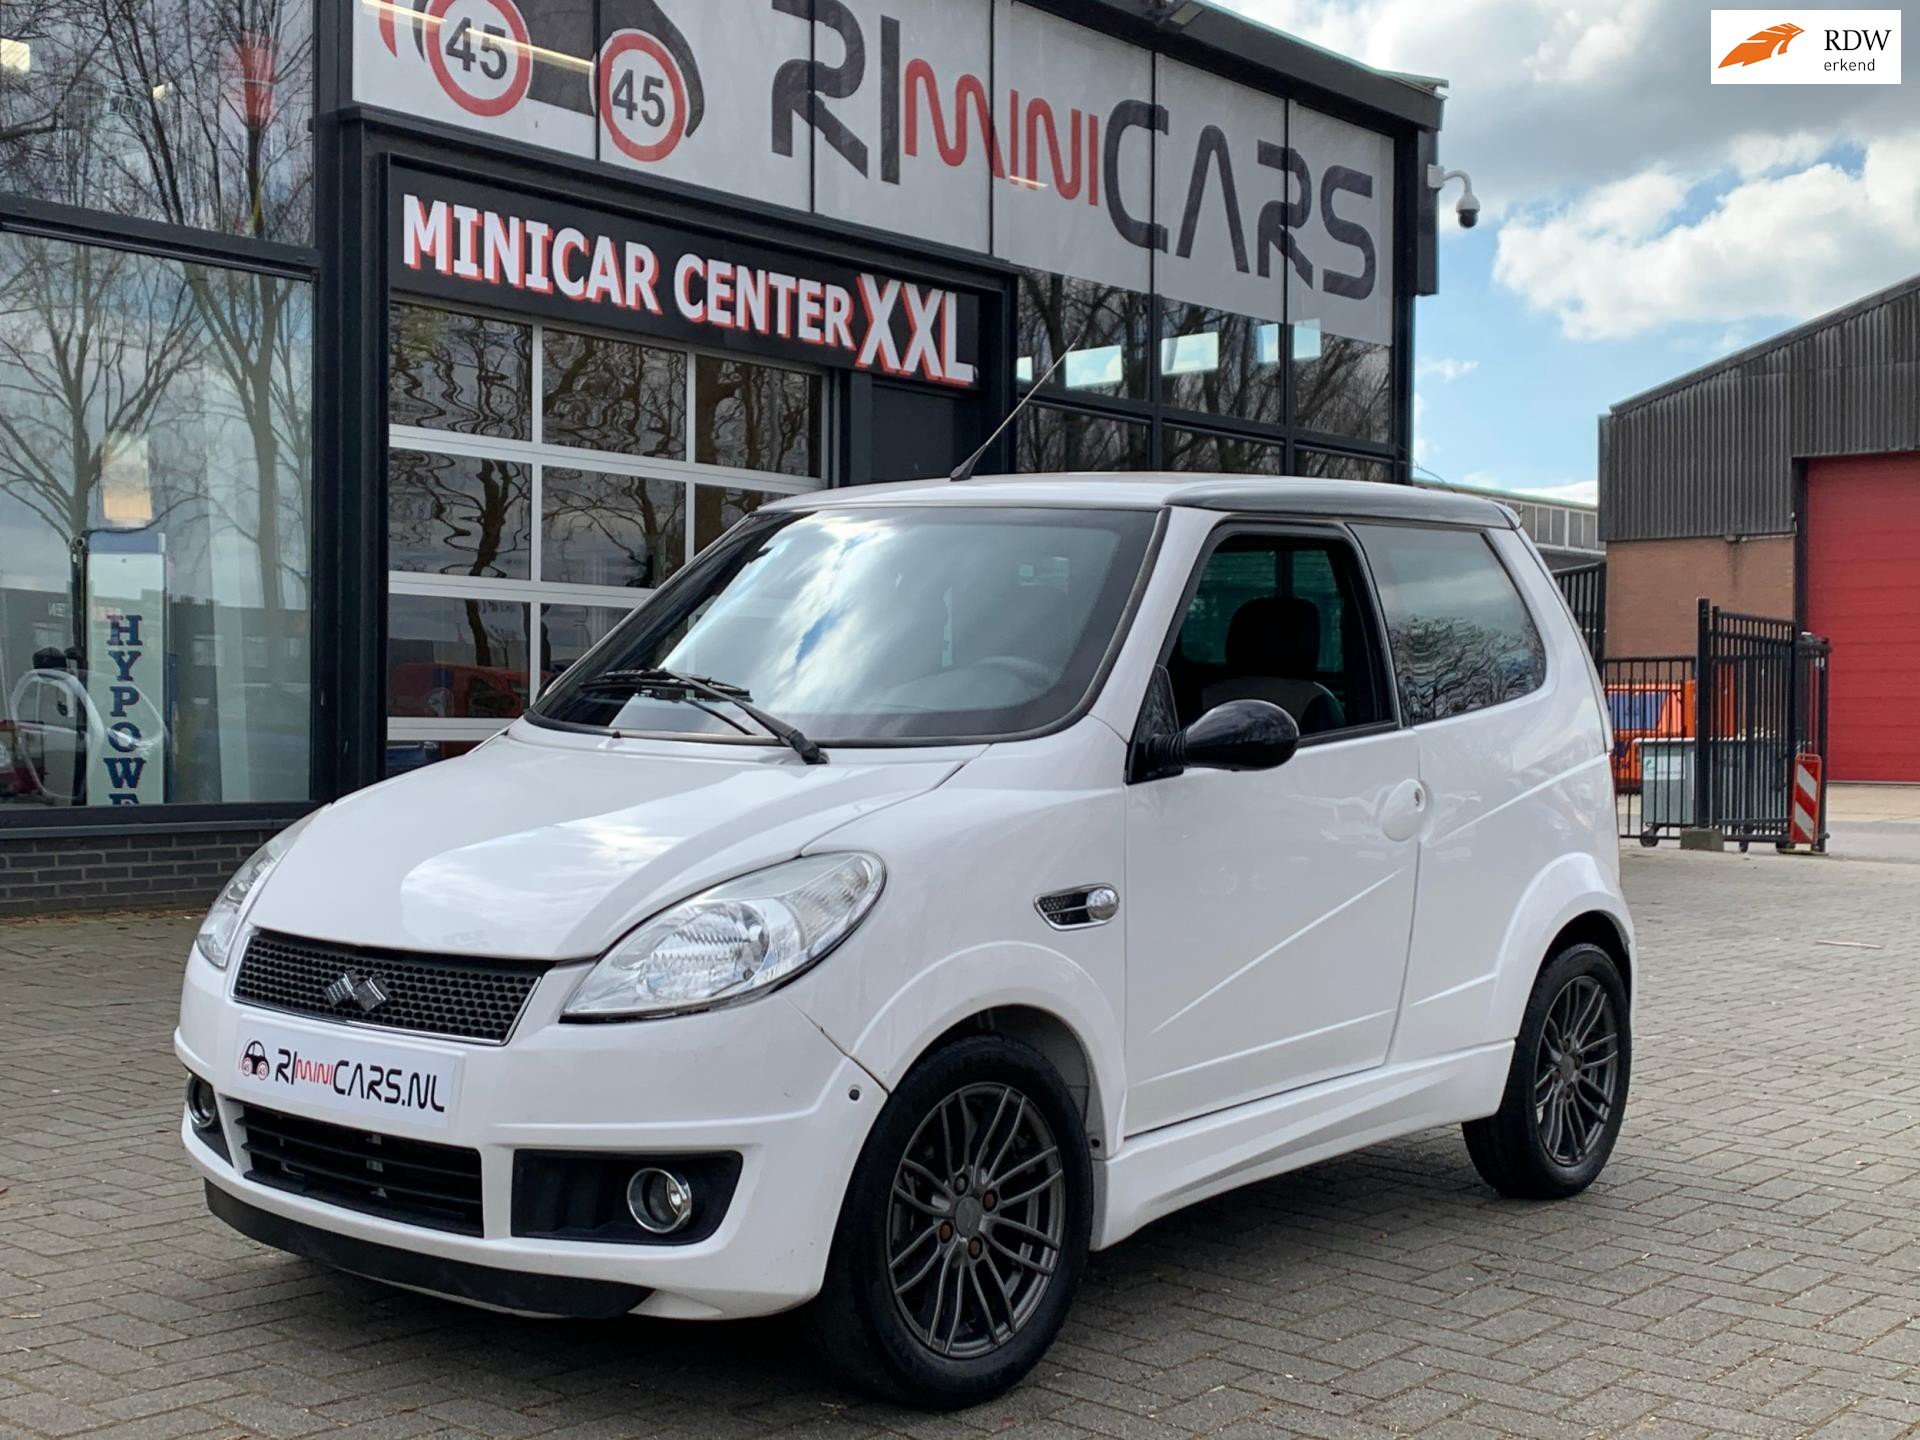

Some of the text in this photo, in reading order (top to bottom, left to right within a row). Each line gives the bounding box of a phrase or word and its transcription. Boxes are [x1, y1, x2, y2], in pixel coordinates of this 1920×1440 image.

[446, 16, 508, 81] 45
[612, 68, 666, 128] 45
[403, 193, 976, 387] MINICAR CENTER XXL
